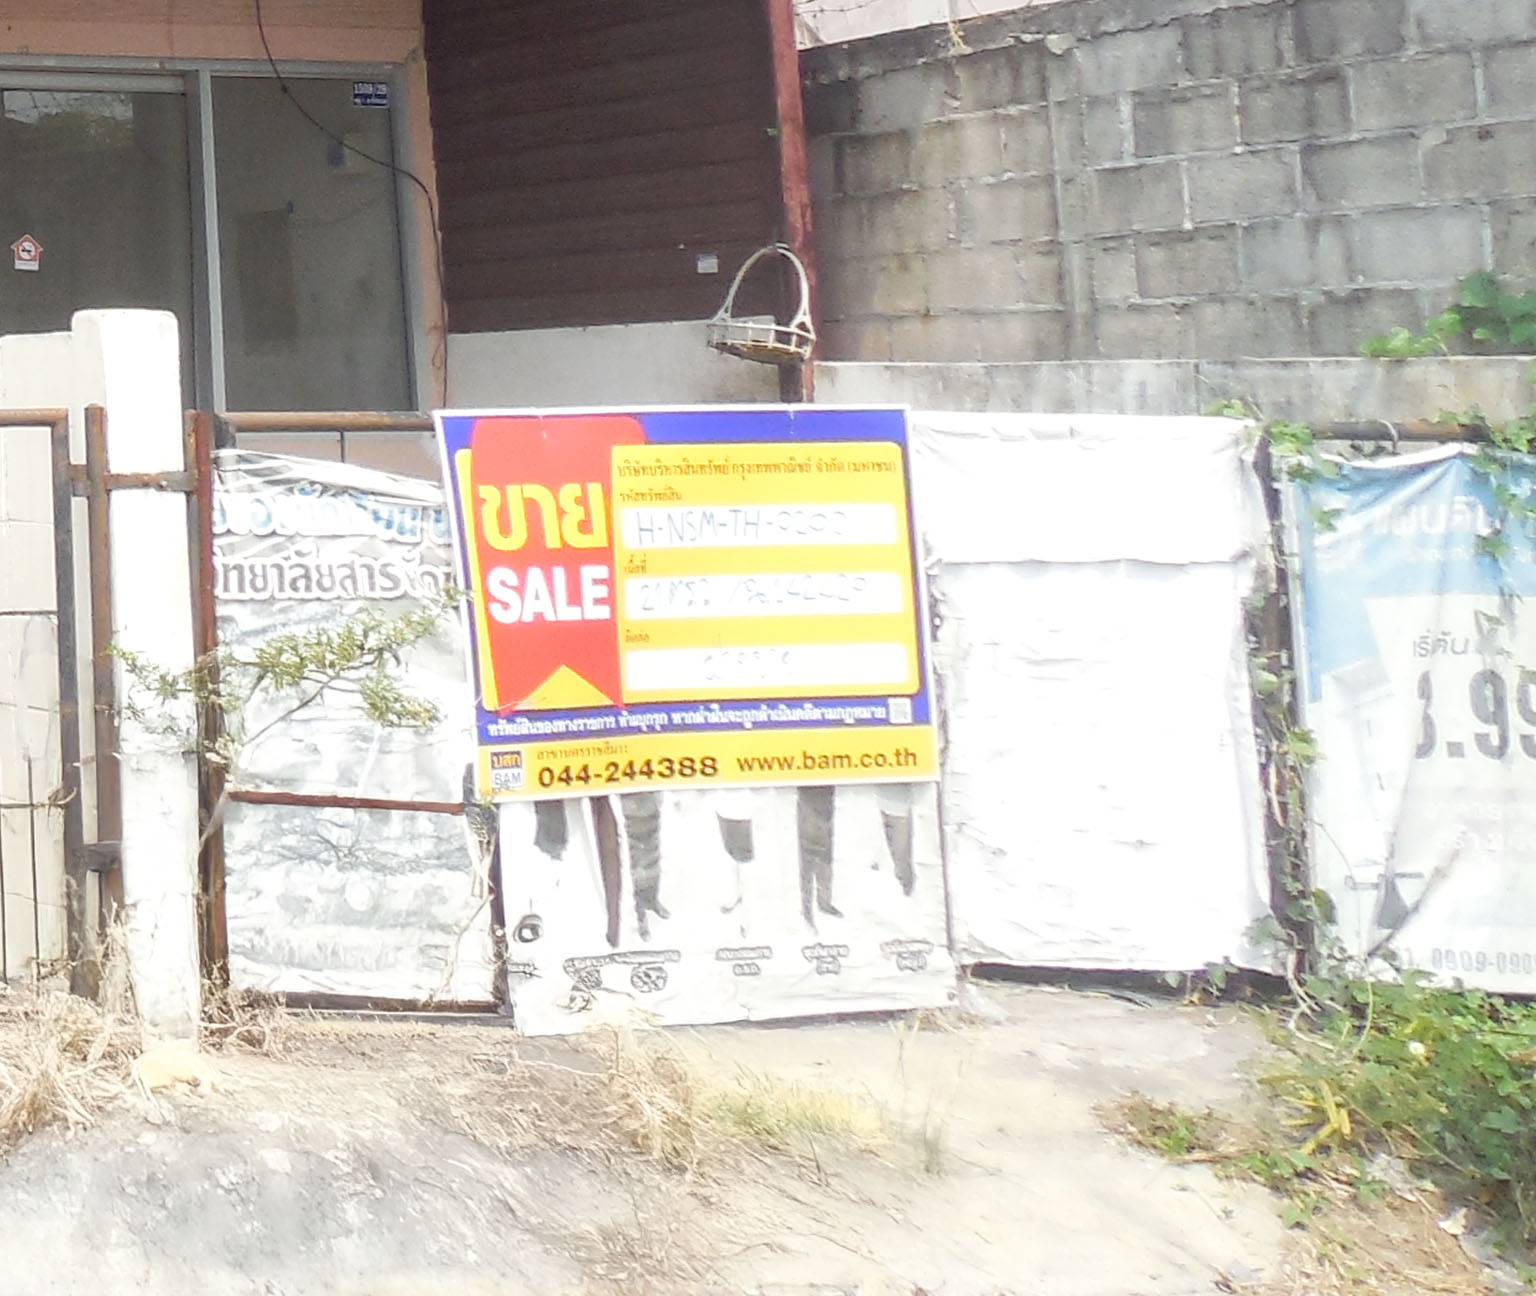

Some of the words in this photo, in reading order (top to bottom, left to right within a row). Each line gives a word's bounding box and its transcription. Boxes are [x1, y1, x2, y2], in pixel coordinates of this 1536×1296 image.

[478, 483, 608, 551] ขาย
[487, 564, 611, 624] SALE
[493, 753, 521, 769] บสก
[538, 755, 719, 788] 044-244388
[736, 747, 918, 772] www.bam.co.th
